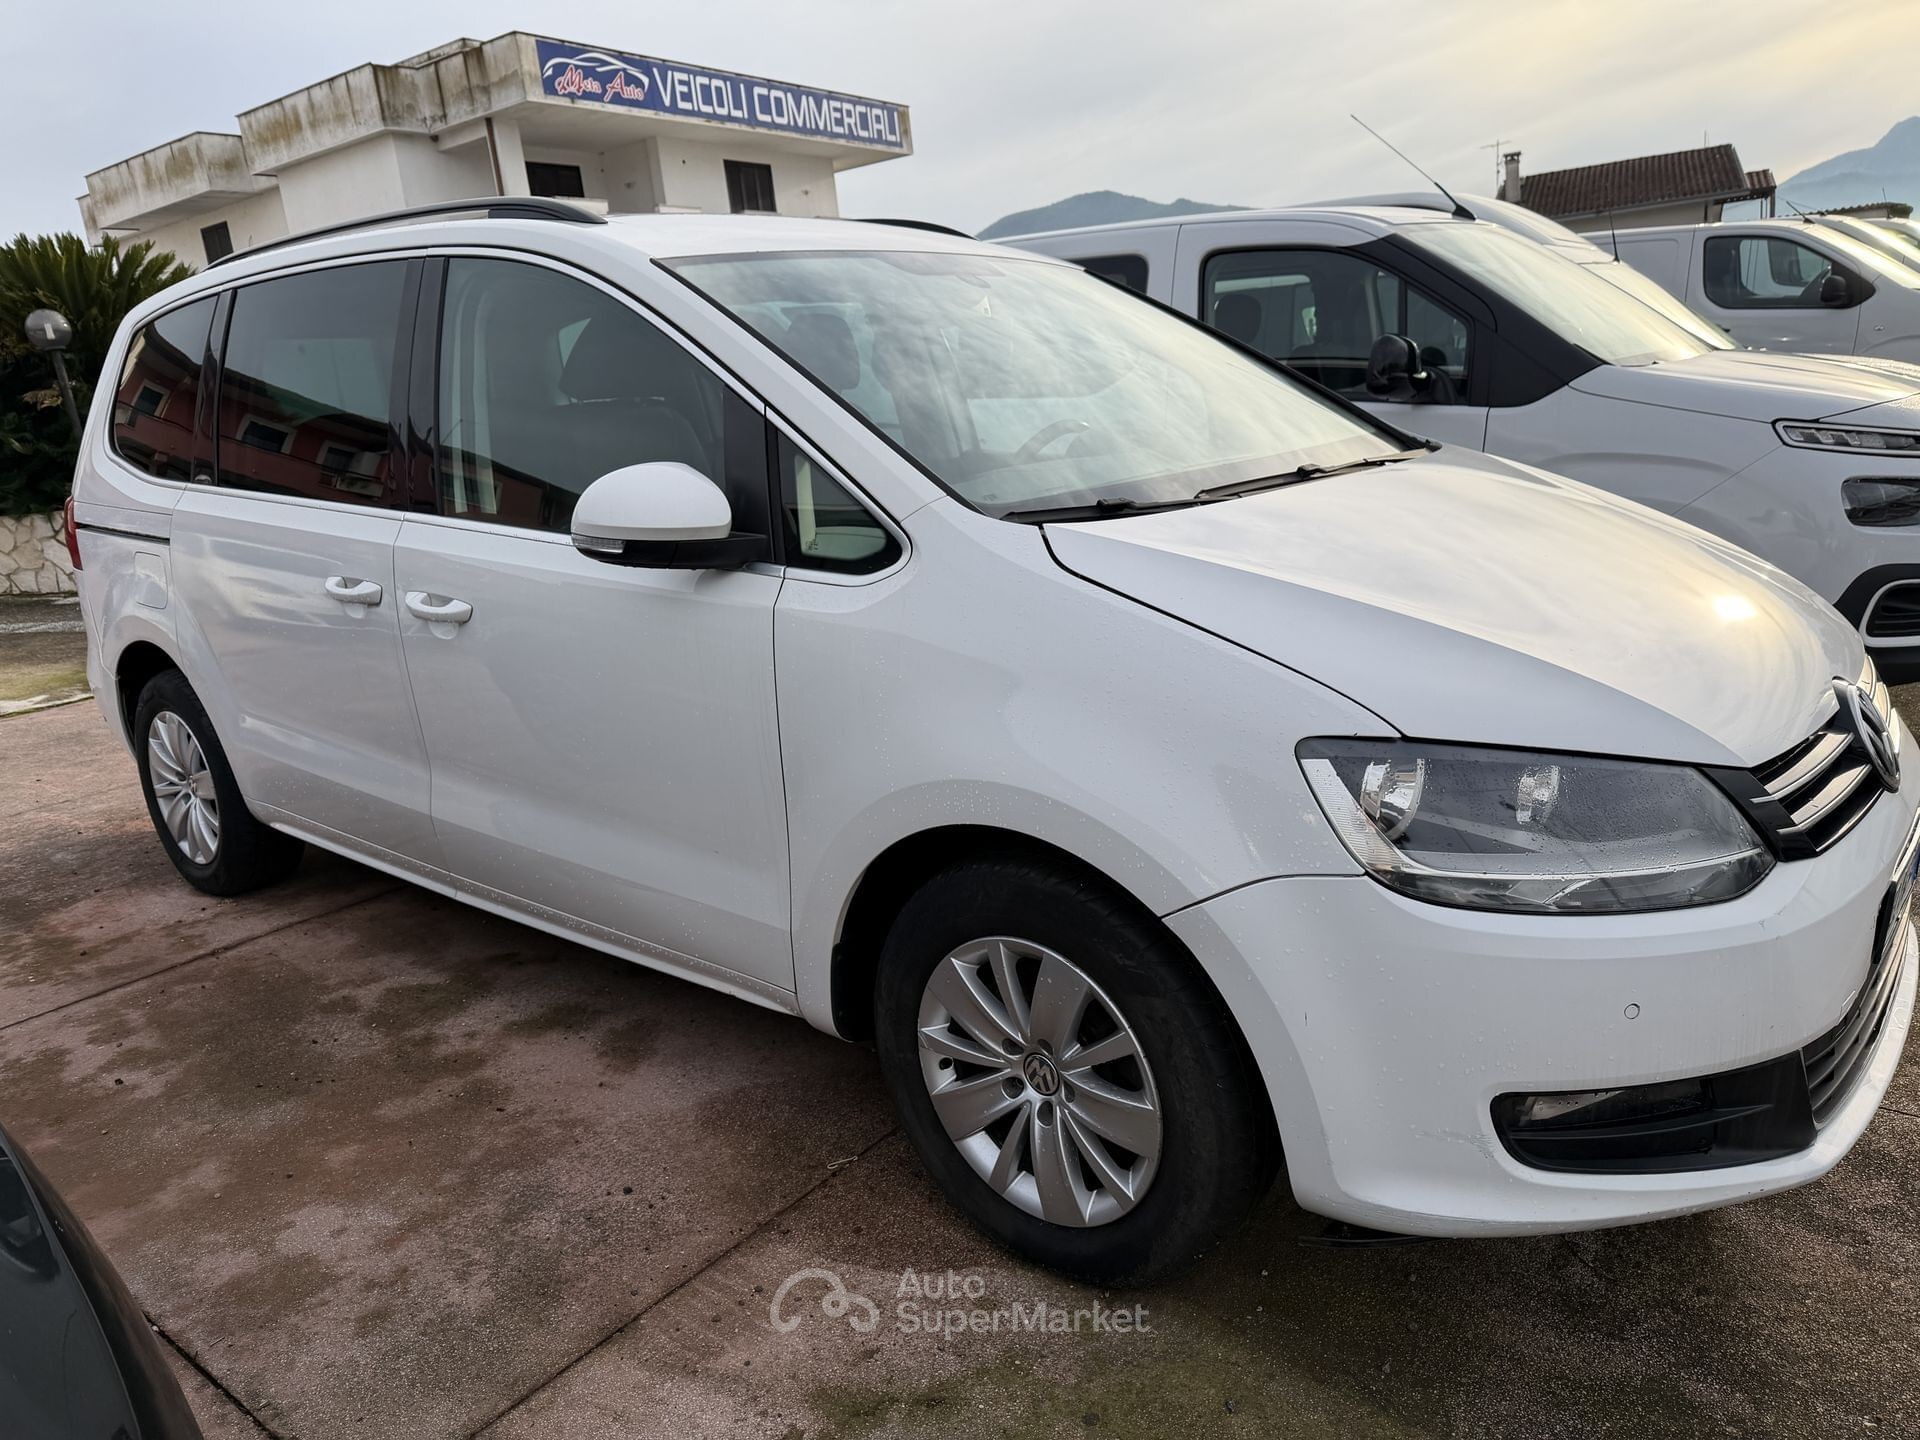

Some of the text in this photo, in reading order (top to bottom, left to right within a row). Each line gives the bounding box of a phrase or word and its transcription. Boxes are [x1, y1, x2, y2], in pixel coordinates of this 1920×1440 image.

[604, 71, 644, 102] Auto
[652, 67, 900, 142] VEICOLI COMMERCIALI
